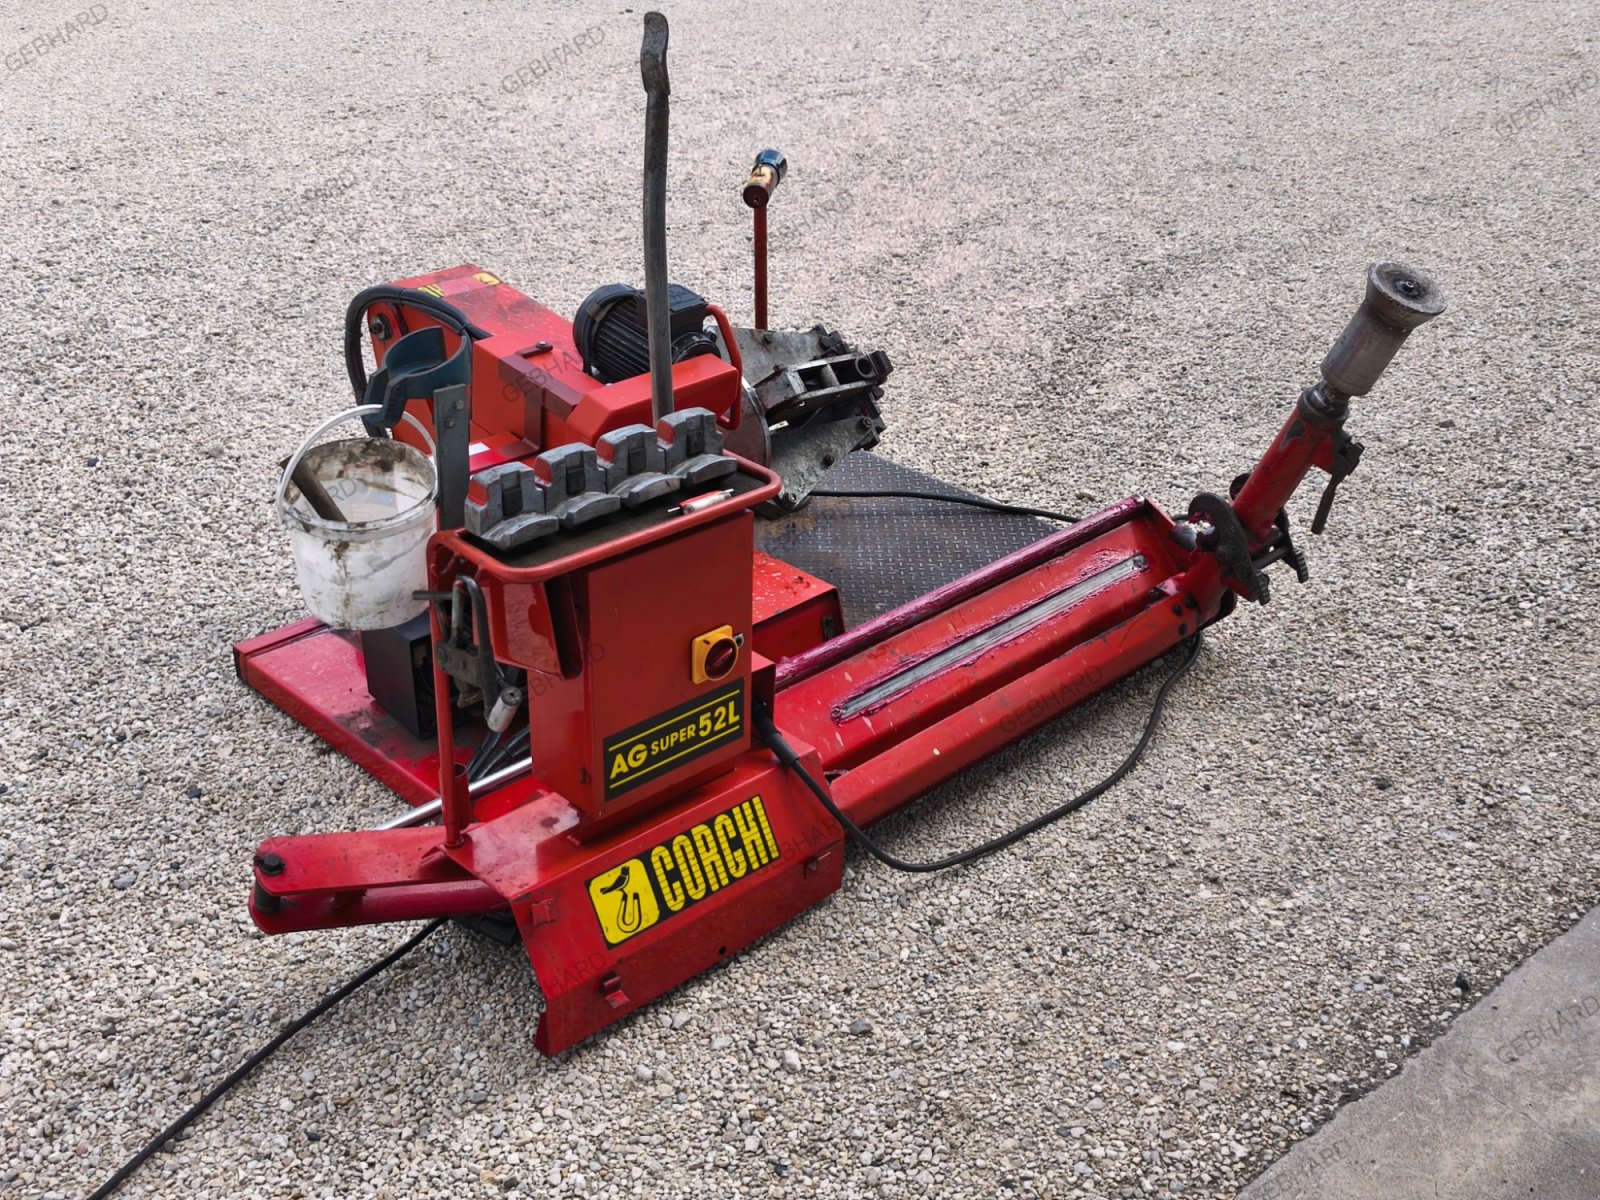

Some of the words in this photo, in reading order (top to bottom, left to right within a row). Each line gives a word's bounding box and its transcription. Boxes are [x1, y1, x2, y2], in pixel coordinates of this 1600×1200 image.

[610, 744, 648, 779] AG
[651, 724, 695, 755] SUPER
[699, 701, 740, 737] 52L
[651, 795, 780, 912] CORCHI
